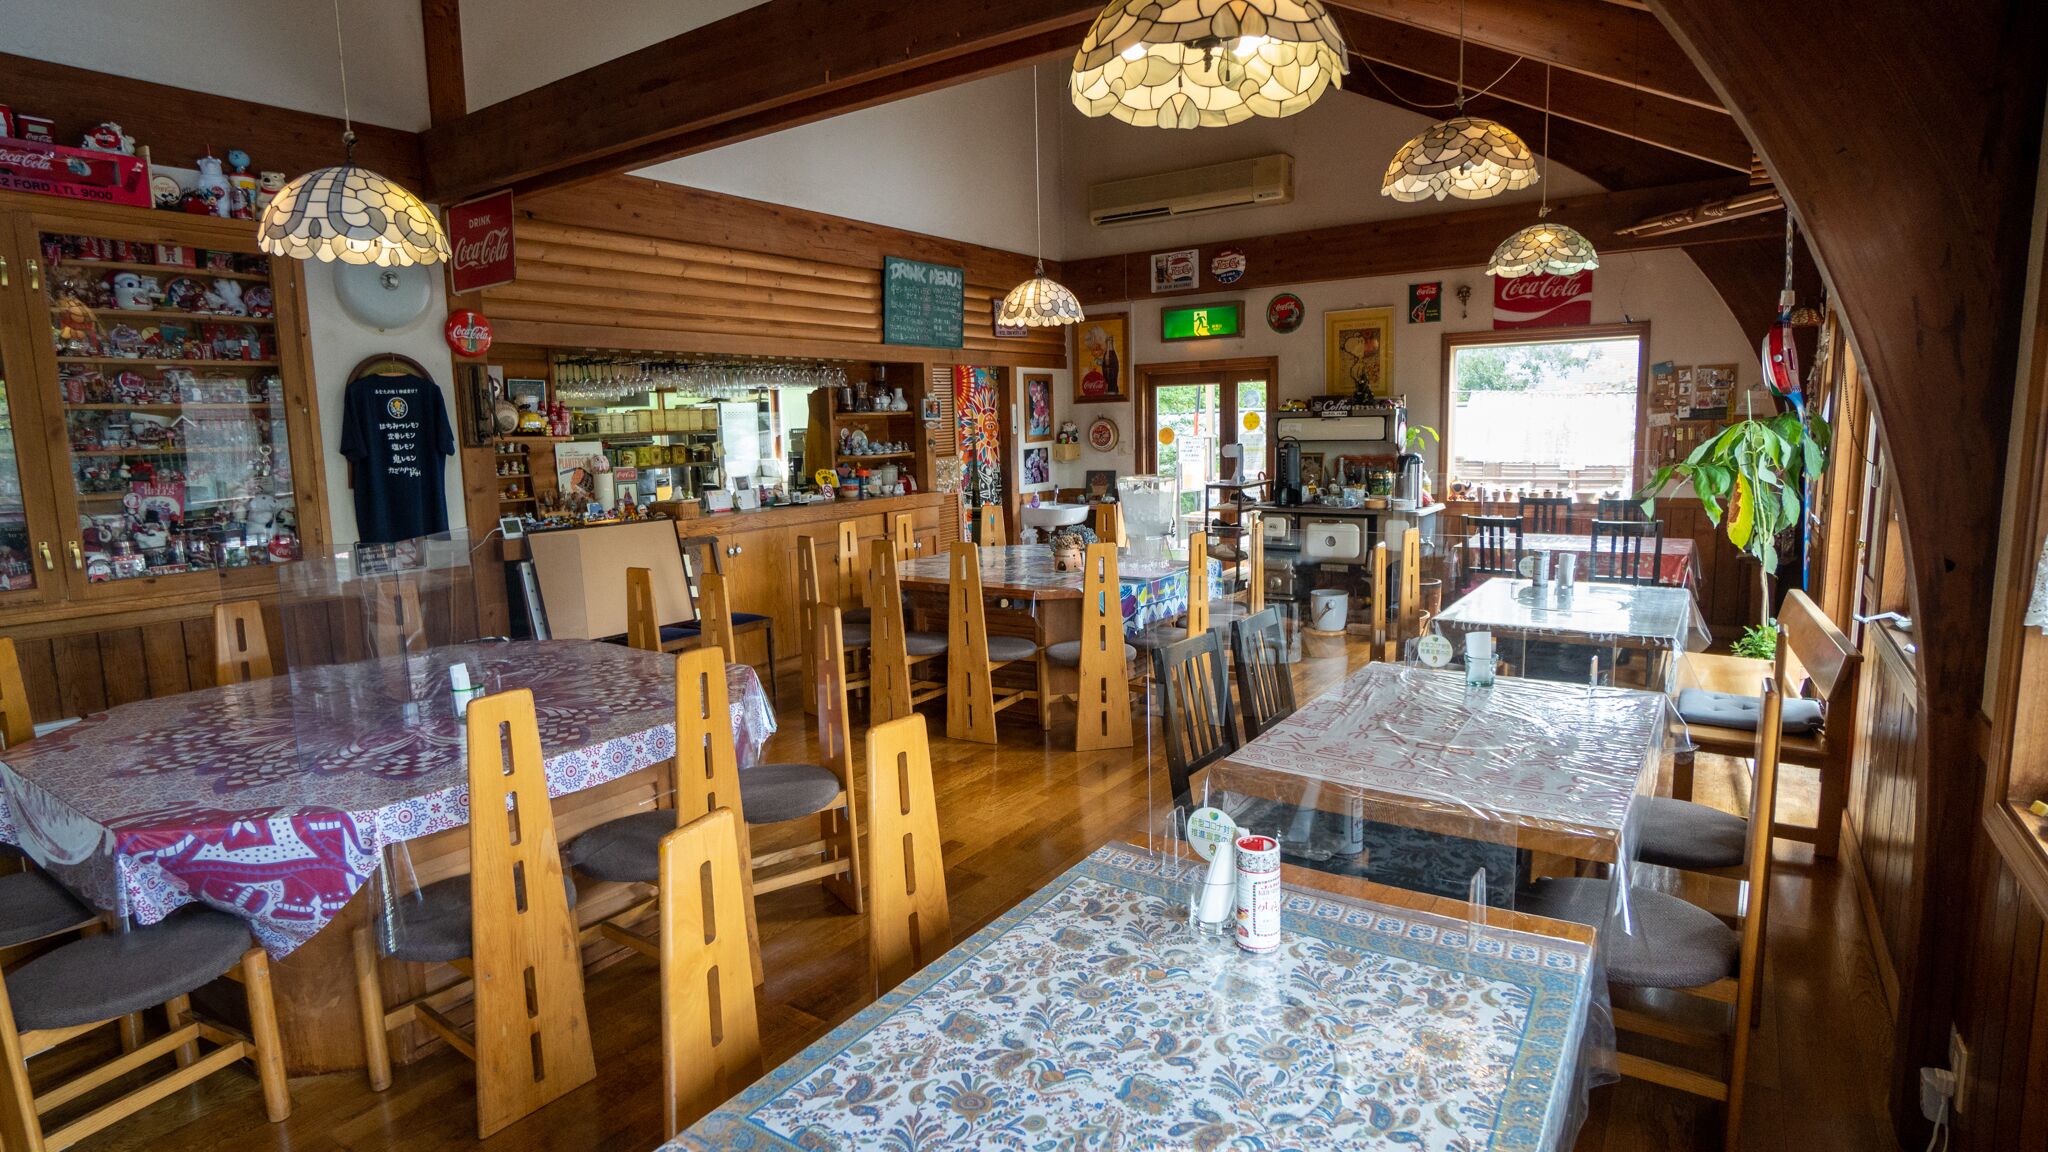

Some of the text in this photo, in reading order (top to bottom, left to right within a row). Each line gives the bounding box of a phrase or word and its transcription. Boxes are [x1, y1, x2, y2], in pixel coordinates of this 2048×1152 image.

[14, 180, 50, 192] FORD
[81, 189, 112, 200] 9000
[469, 215, 491, 228] DRINK
[455, 227, 509, 270] Coca-Cola
[890, 263, 926, 283] DRINK
[453, 325, 489, 339] Coca-Cola
